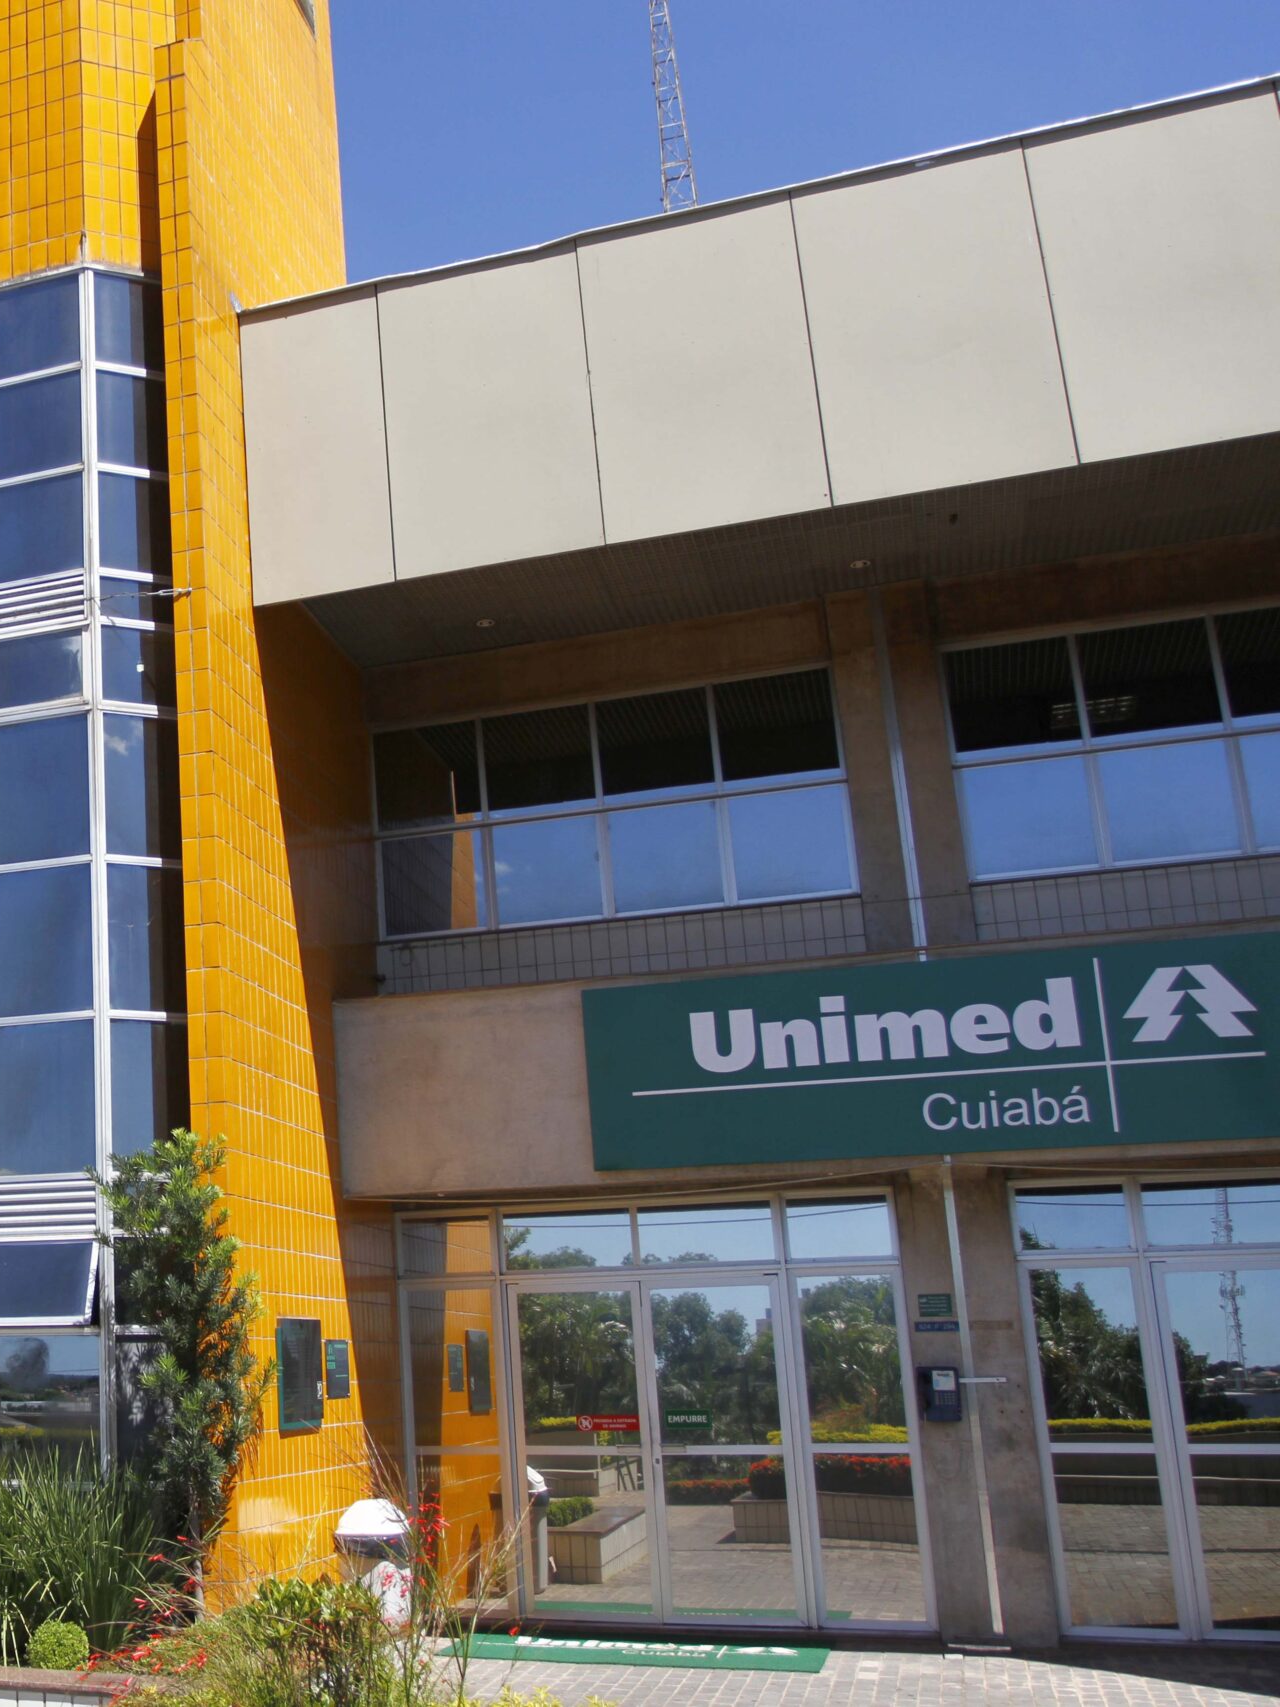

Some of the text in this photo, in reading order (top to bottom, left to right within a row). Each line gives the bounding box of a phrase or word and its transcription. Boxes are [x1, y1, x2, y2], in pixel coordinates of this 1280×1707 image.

[688, 976, 1082, 1073] Unimed
[922, 1085, 1091, 1131] Cuiabá
[667, 1414, 708, 1424] EMPURRE
[515, 1636, 715, 1651] Unimed
